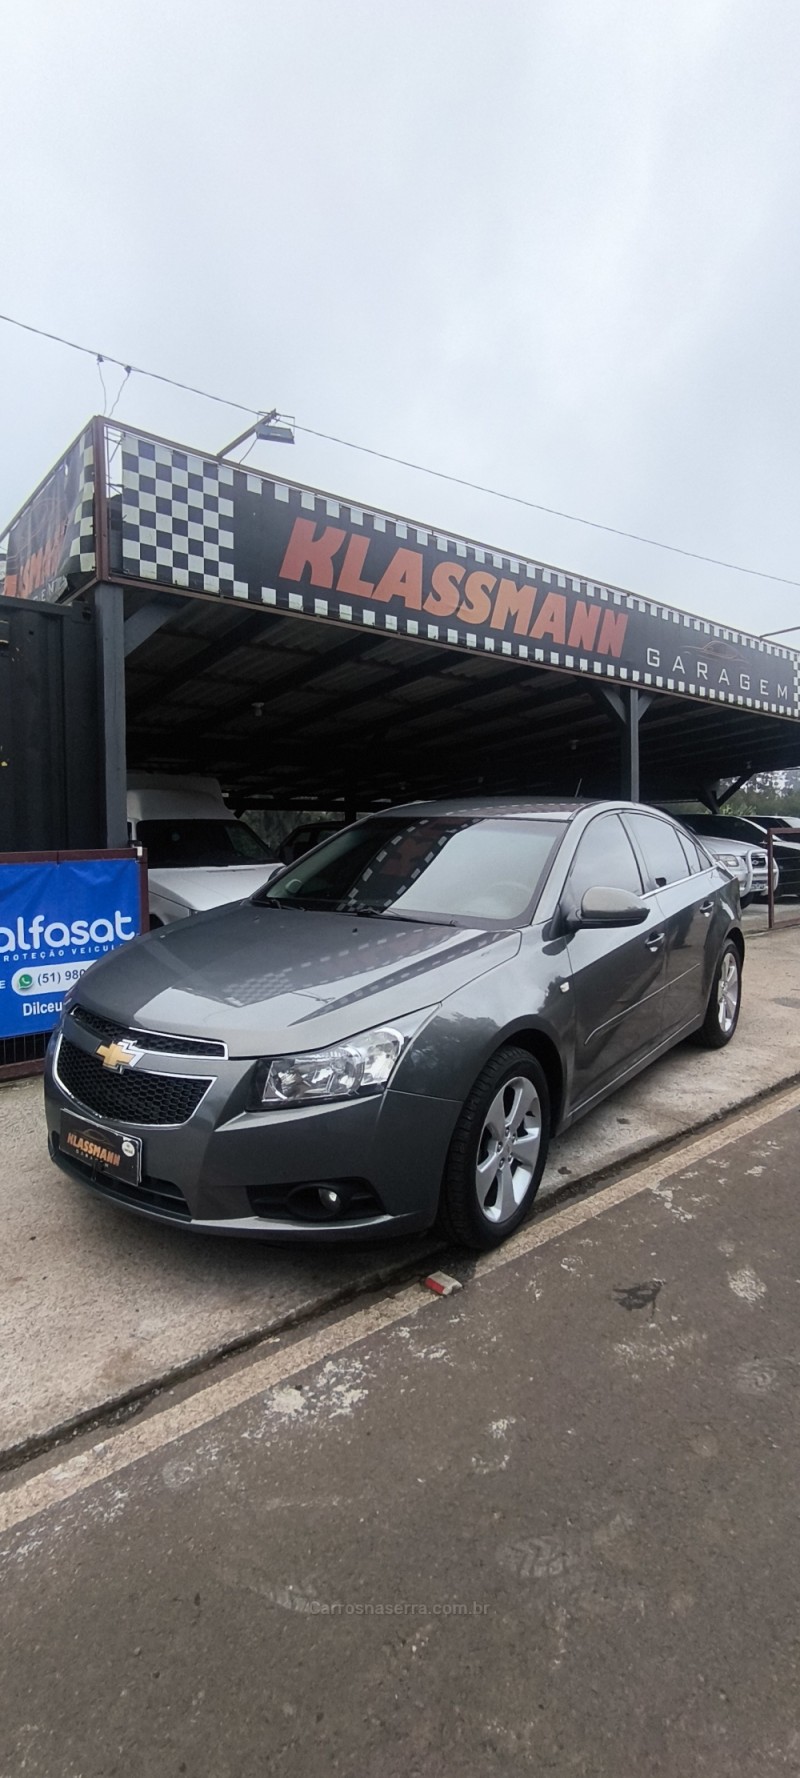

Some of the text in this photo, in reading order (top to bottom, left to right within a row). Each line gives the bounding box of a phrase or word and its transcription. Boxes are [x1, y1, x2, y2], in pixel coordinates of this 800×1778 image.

[279, 517, 789, 701] KLASSMANN GARAGEM
[0, 910, 135, 953] alfasat
[3, 943, 123, 962] ROTEÇÃO VEICUL
[37, 972, 61, 986] (51)
[22, 1001, 63, 1017] Dilceu
[67, 1132, 120, 1167] KLASSMANN
